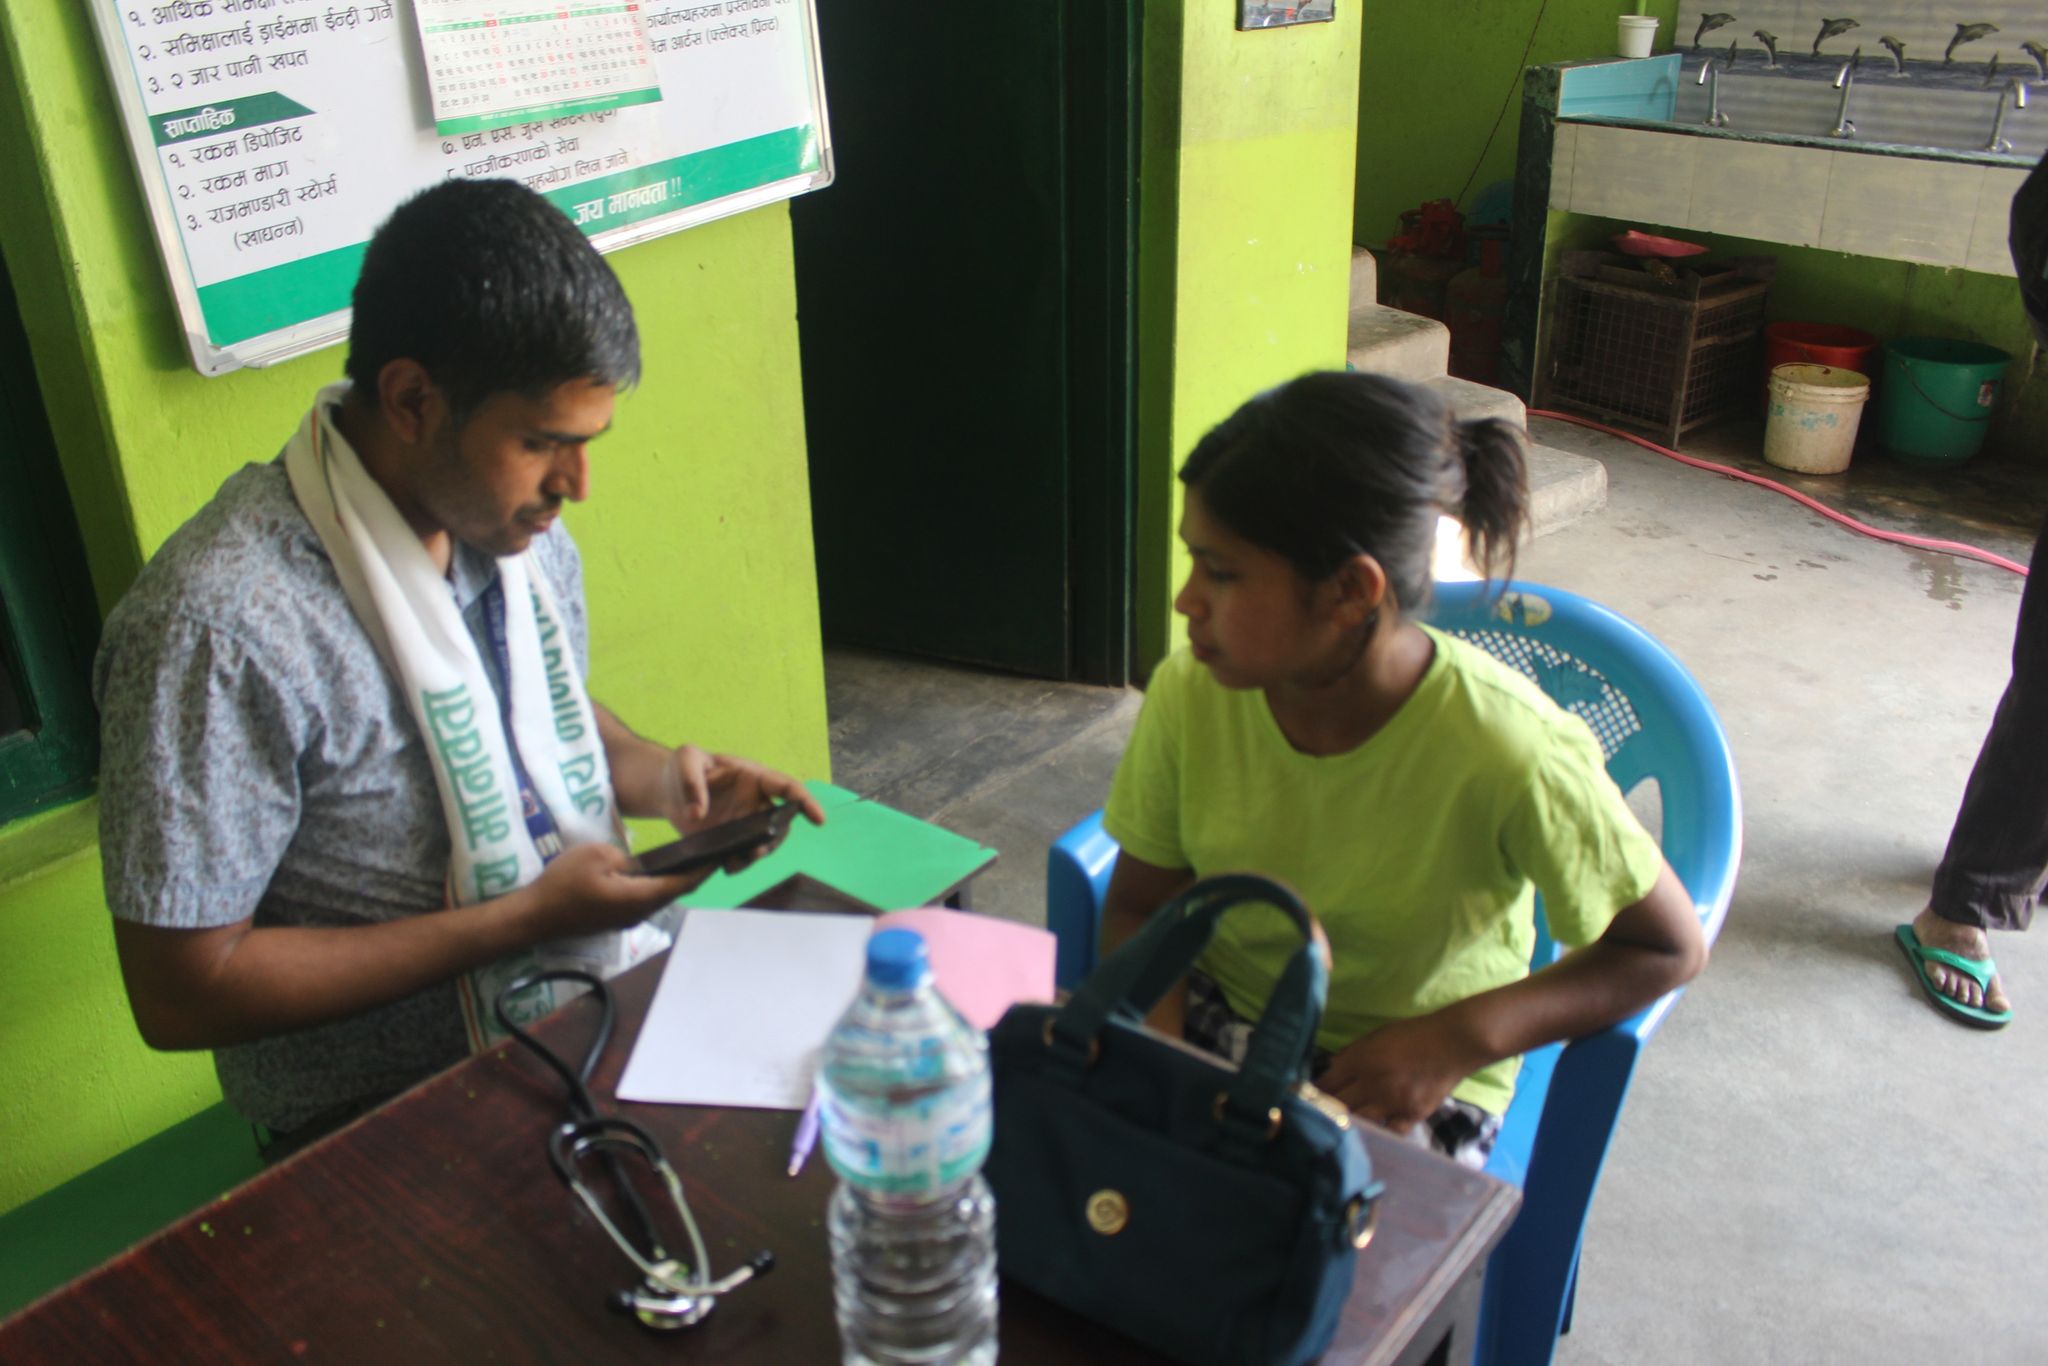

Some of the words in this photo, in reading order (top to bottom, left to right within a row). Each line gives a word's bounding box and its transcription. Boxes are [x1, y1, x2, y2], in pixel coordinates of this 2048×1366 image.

[646, 7, 722, 28] ार्यालयहरुमा
[138, 45, 157, 61] २.
[148, 77, 164, 94] ३.
[170, 73, 184, 89] २
[188, 65, 222, 86] जार
[225, 54, 263, 78] पानी
[266, 49, 309, 70] खपत
[190, 139, 239, 164] रकम
[243, 126, 303, 154] डिपोजिट
[555, 136, 580, 155] सेवा
[177, 184, 196, 200] २.
[199, 169, 248, 194] रकम
[573, 198, 605, 226] जय
[608, 180, 668, 215] मानवता
[186, 213, 203, 231] ३.
